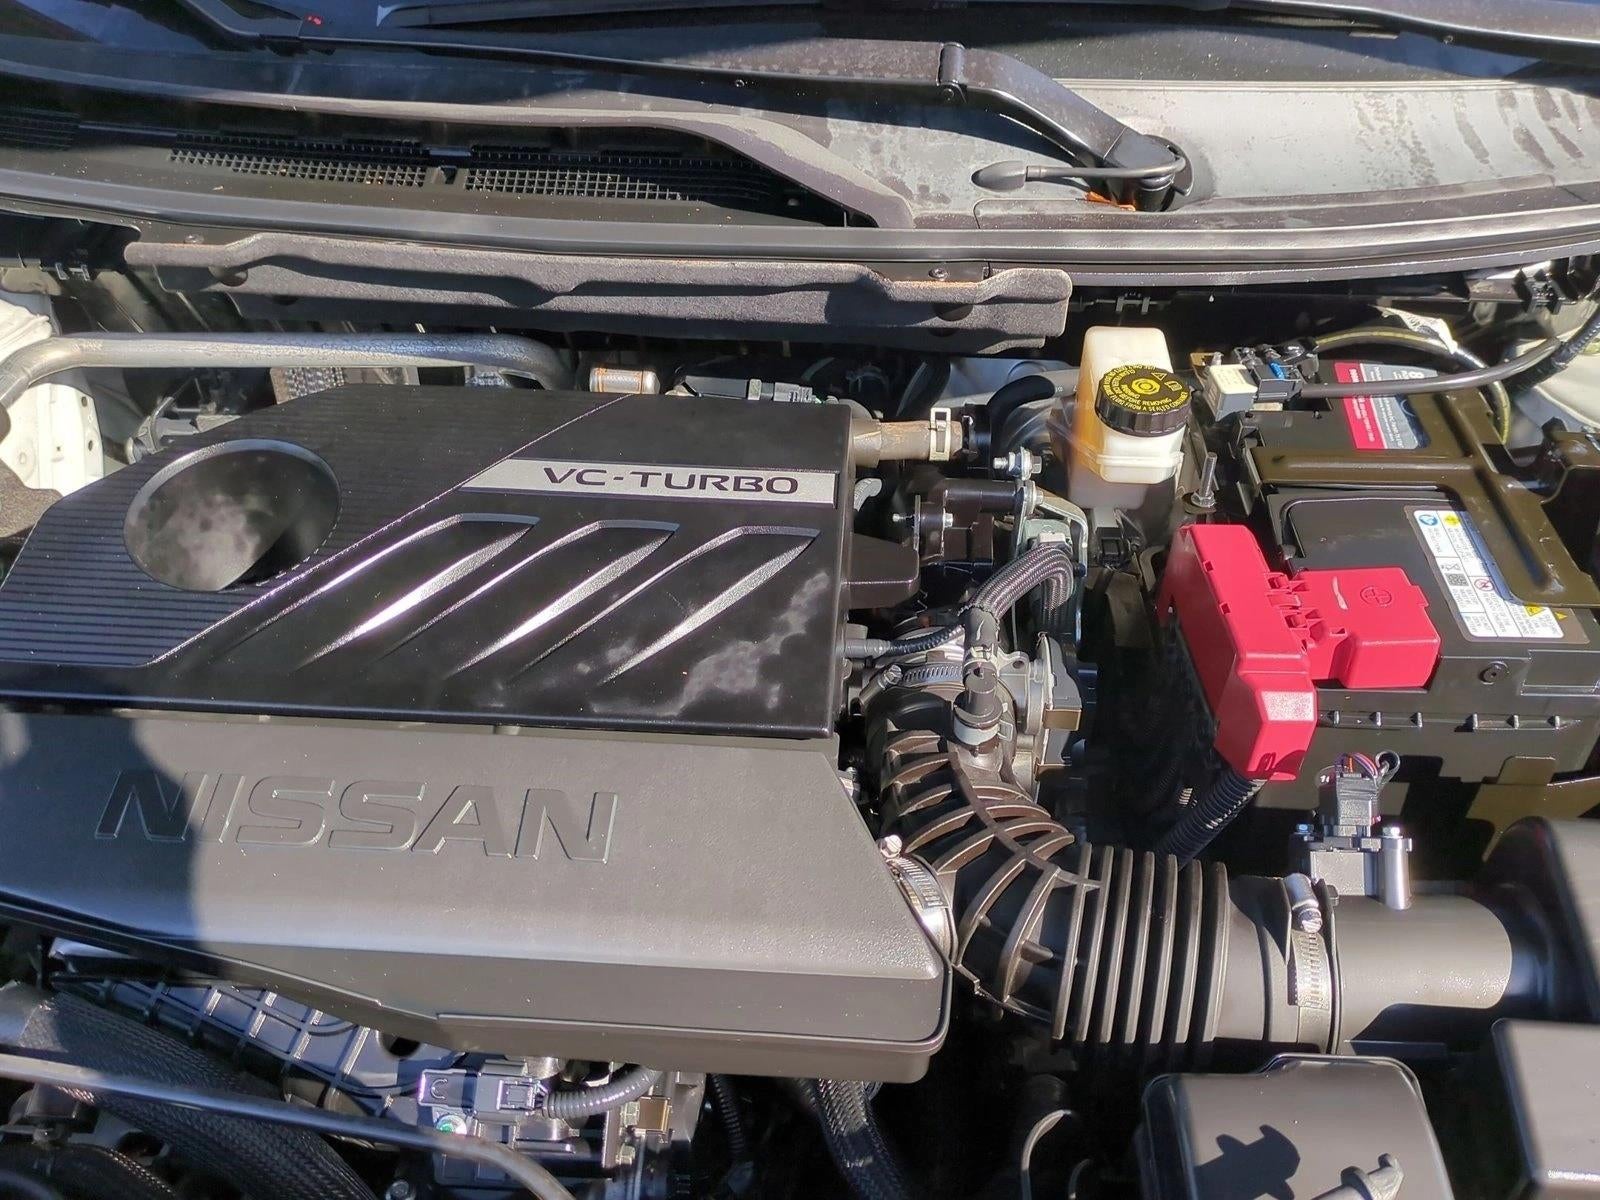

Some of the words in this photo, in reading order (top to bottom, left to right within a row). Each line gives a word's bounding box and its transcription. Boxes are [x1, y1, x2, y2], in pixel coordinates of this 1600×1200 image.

[1141, 397, 1172, 407] REMOVING
[543, 467, 799, 495] VC-TURBO
[94, 769, 618, 864] NISSAN
